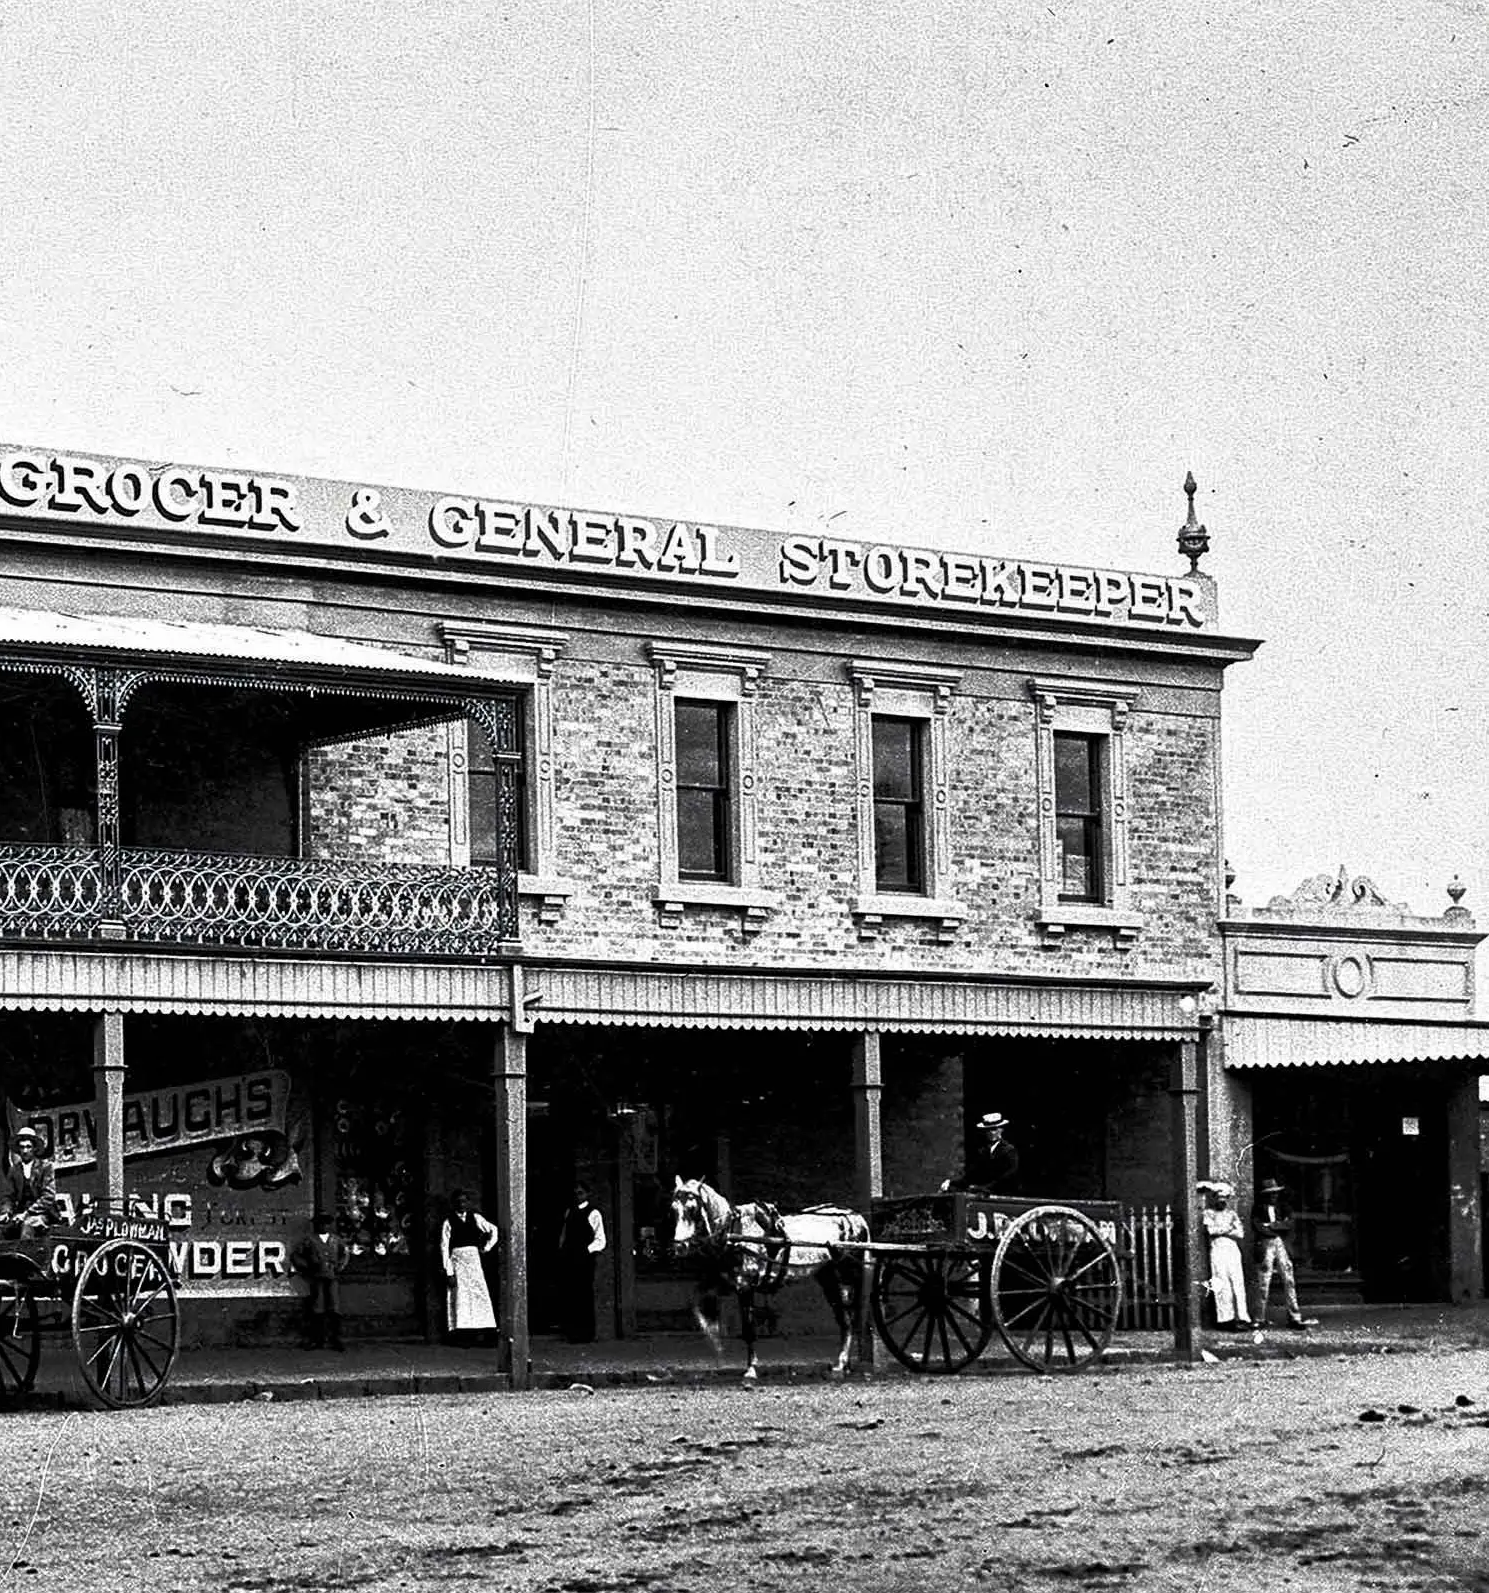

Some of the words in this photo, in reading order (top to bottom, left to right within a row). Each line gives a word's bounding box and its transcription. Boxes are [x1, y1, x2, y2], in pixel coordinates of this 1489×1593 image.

[345, 485, 391, 542] &
[428, 494, 740, 579] GENERAL
[778, 531, 1207, 629] STOREKEEPER
[105, 1218, 167, 1241] PLOWMAN
